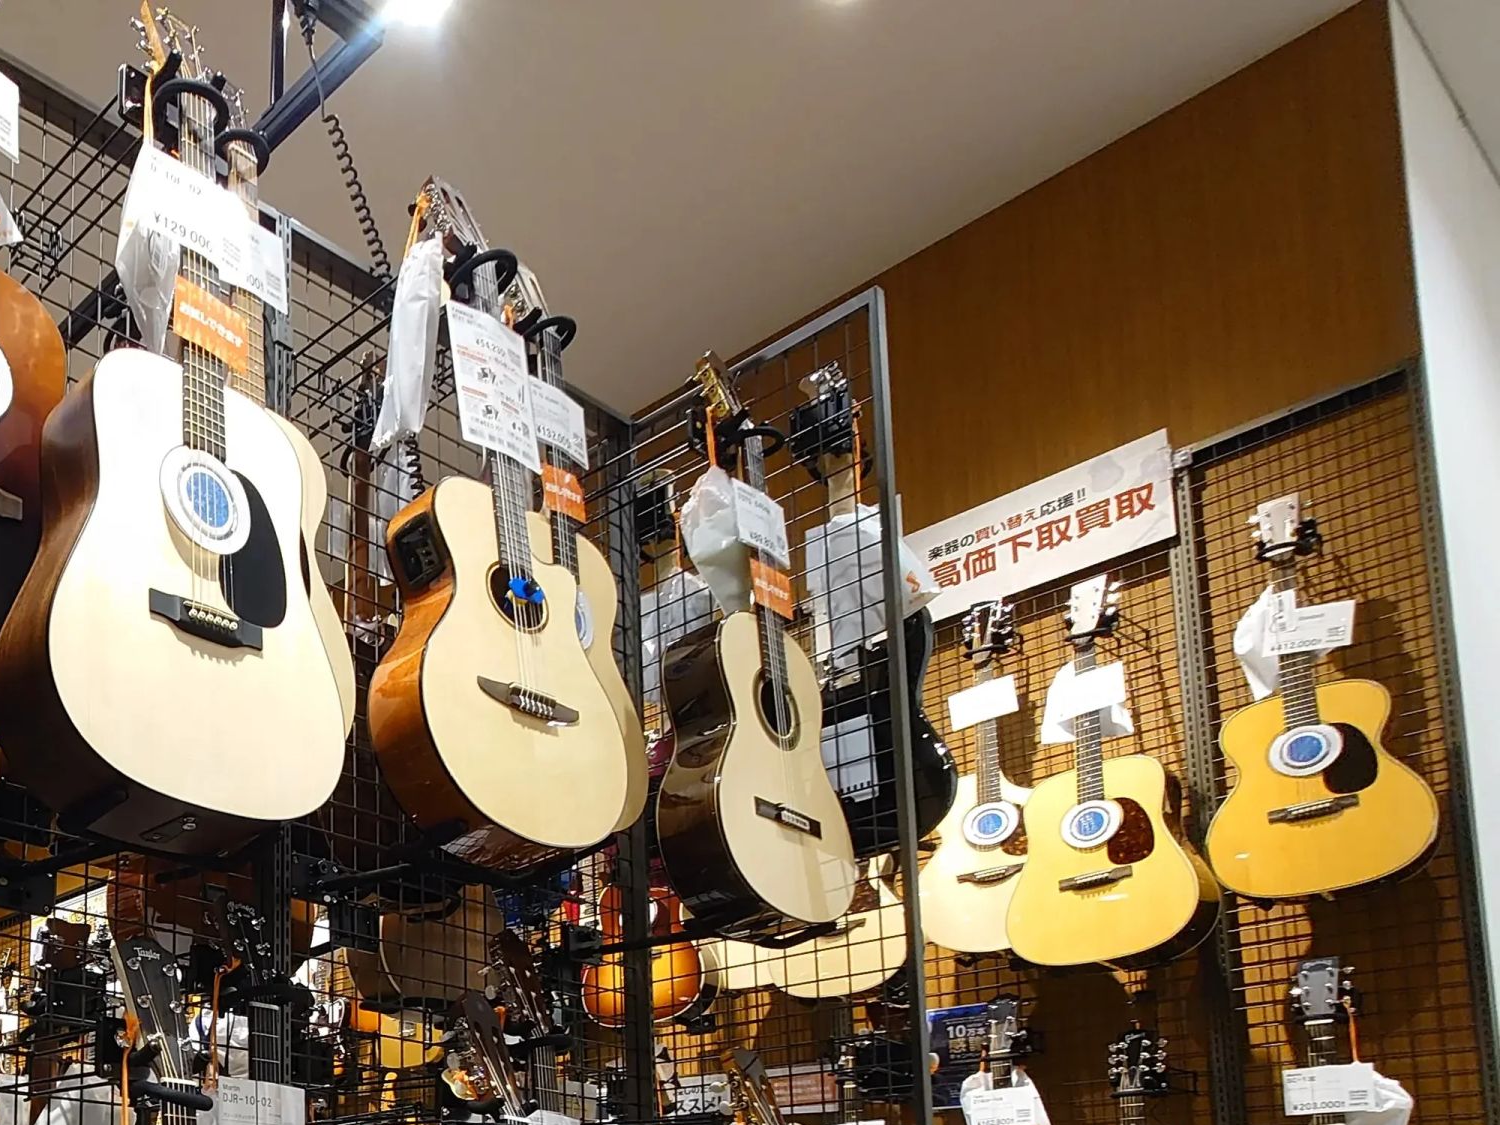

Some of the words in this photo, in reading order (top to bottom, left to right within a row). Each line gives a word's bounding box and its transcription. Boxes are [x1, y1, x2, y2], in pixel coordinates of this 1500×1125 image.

[929, 482, 1156, 590] 高価下取買取
